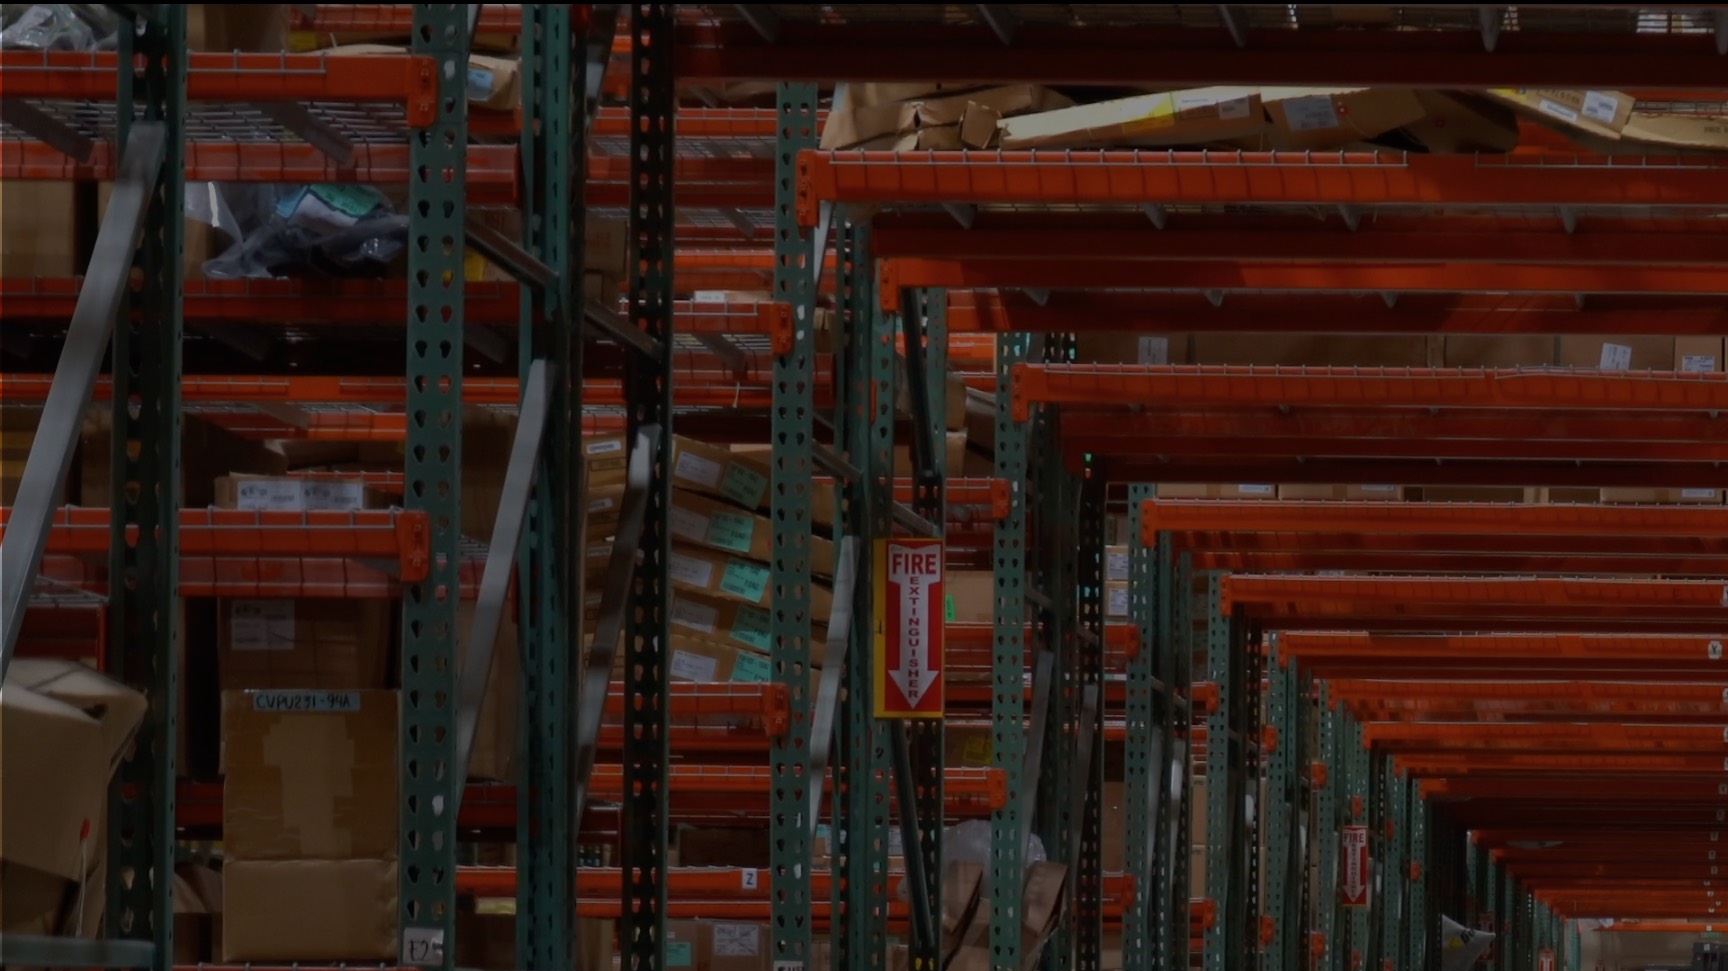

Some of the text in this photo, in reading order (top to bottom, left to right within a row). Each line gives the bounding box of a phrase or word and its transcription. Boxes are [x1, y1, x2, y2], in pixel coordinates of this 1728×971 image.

[892, 554, 936, 575] FIRE
[908, 577, 920, 698] EXTINGUISHER
[1711, 645, 1718, 655] Y
[1344, 832, 1365, 843] FIRE
[746, 873, 754, 885] Z
